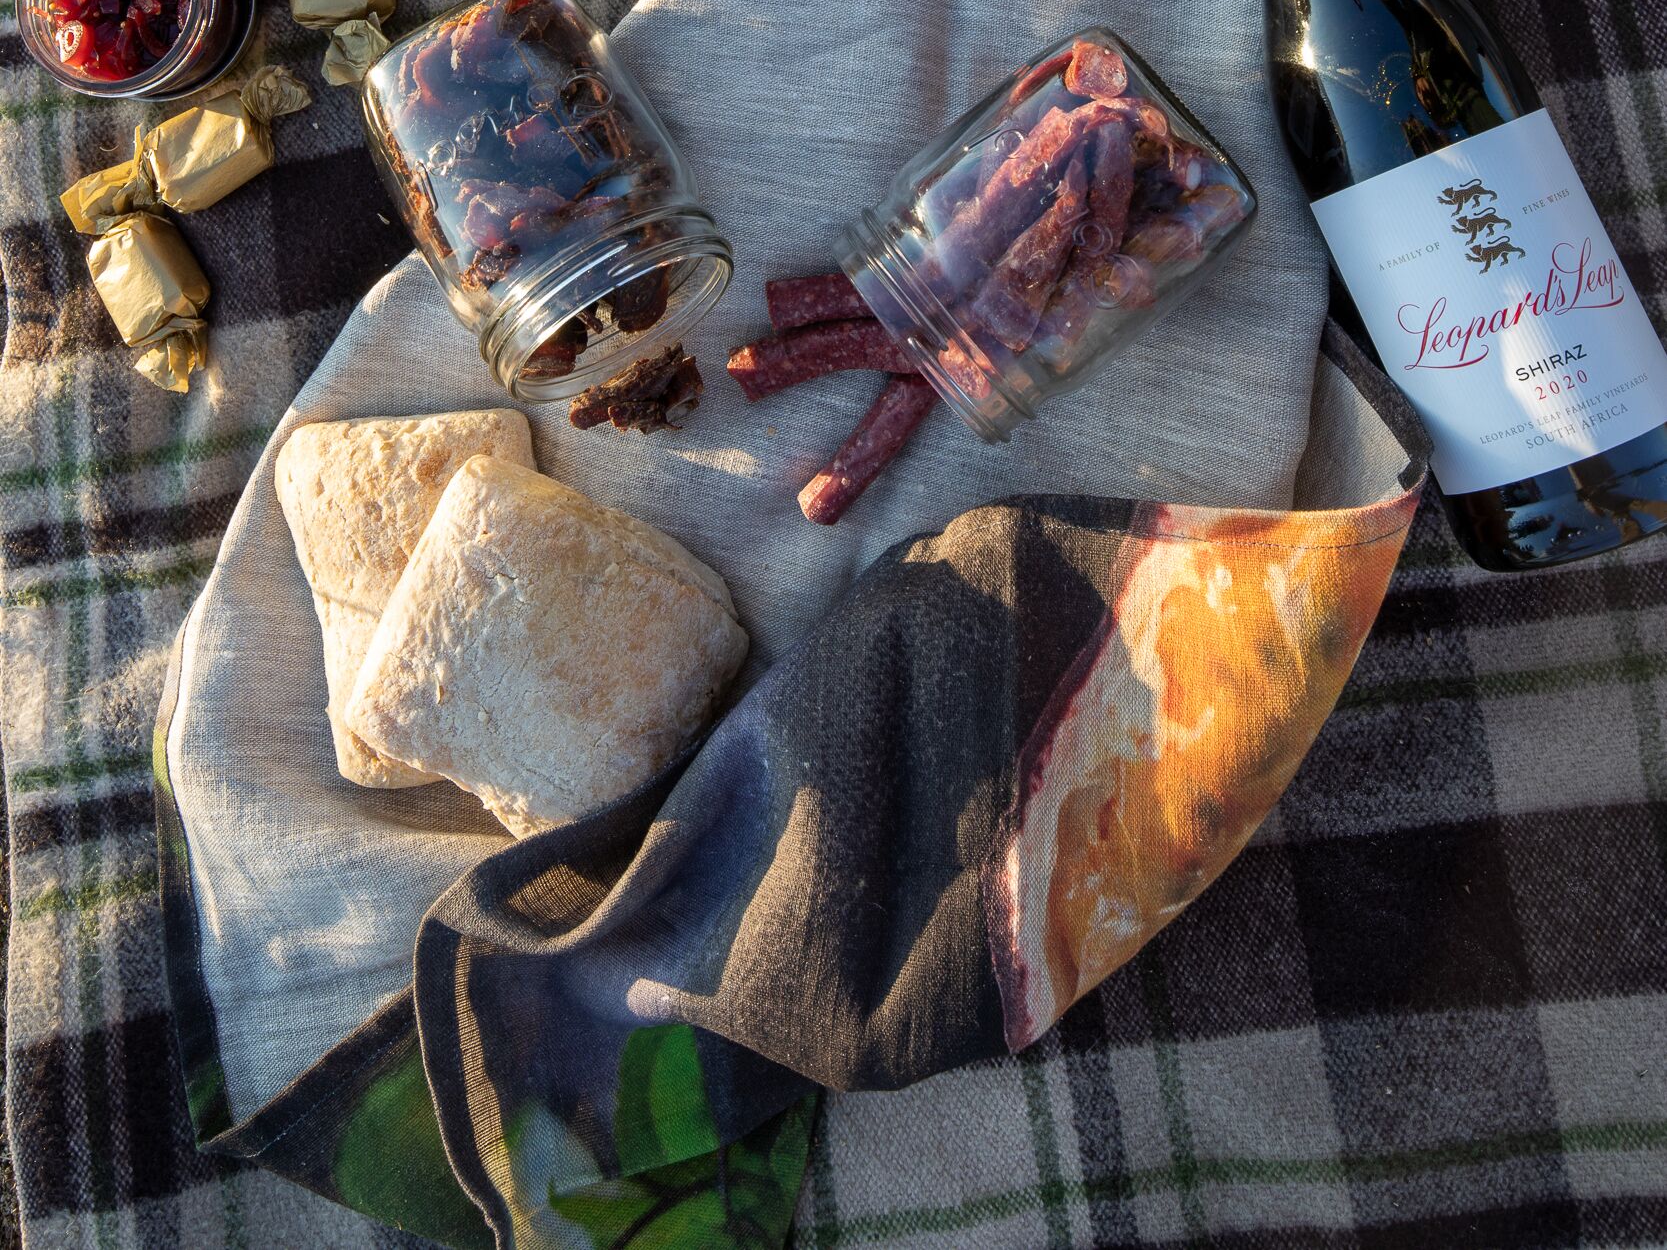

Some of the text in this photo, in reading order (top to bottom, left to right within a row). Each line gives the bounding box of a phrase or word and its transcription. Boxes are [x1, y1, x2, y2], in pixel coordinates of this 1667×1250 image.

[1547, 189, 1570, 203] WINES
[1379, 242, 1440, 271] A FAMILY OF
[1397, 237, 1625, 370] Leopard's Leap
[1515, 344, 1587, 381] SHIRAZ
[1535, 369, 1588, 400] 2020
[1479, 373, 1648, 444] LEOPARD'S LEAP FAMILY VINEYARDS
[1525, 403, 1628, 449] SOUTH AFRICA
